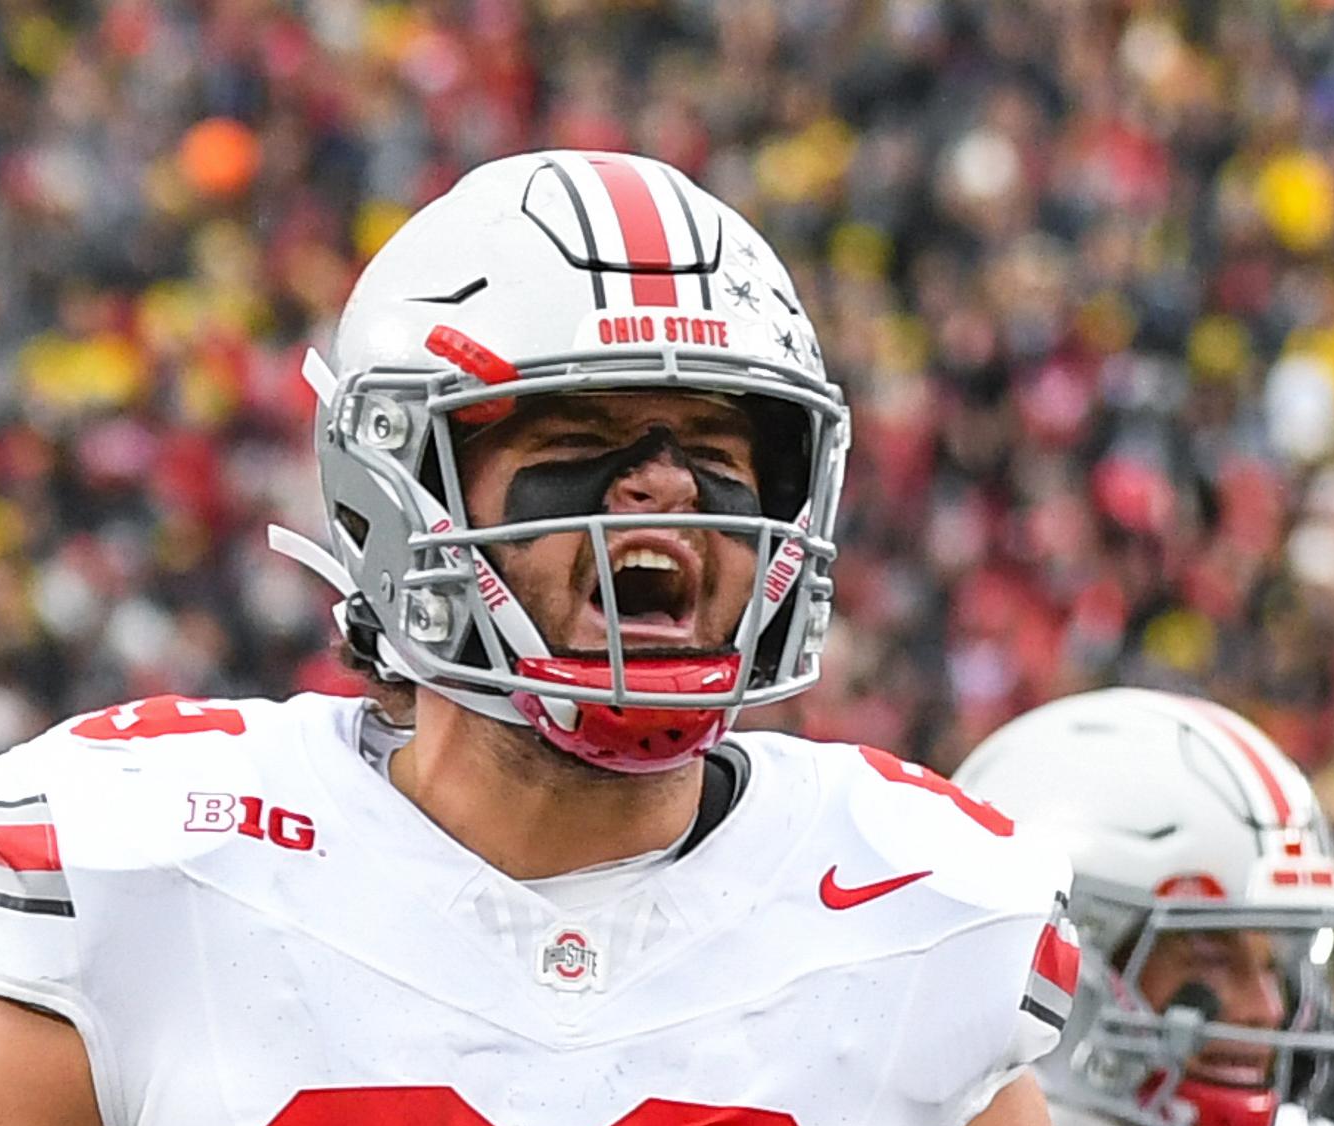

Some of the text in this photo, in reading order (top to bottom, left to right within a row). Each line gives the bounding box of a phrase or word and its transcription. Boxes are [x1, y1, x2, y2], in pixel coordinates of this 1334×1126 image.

[598, 316, 729, 348] OHIO STATE
[764, 560, 795, 603] OHIO
